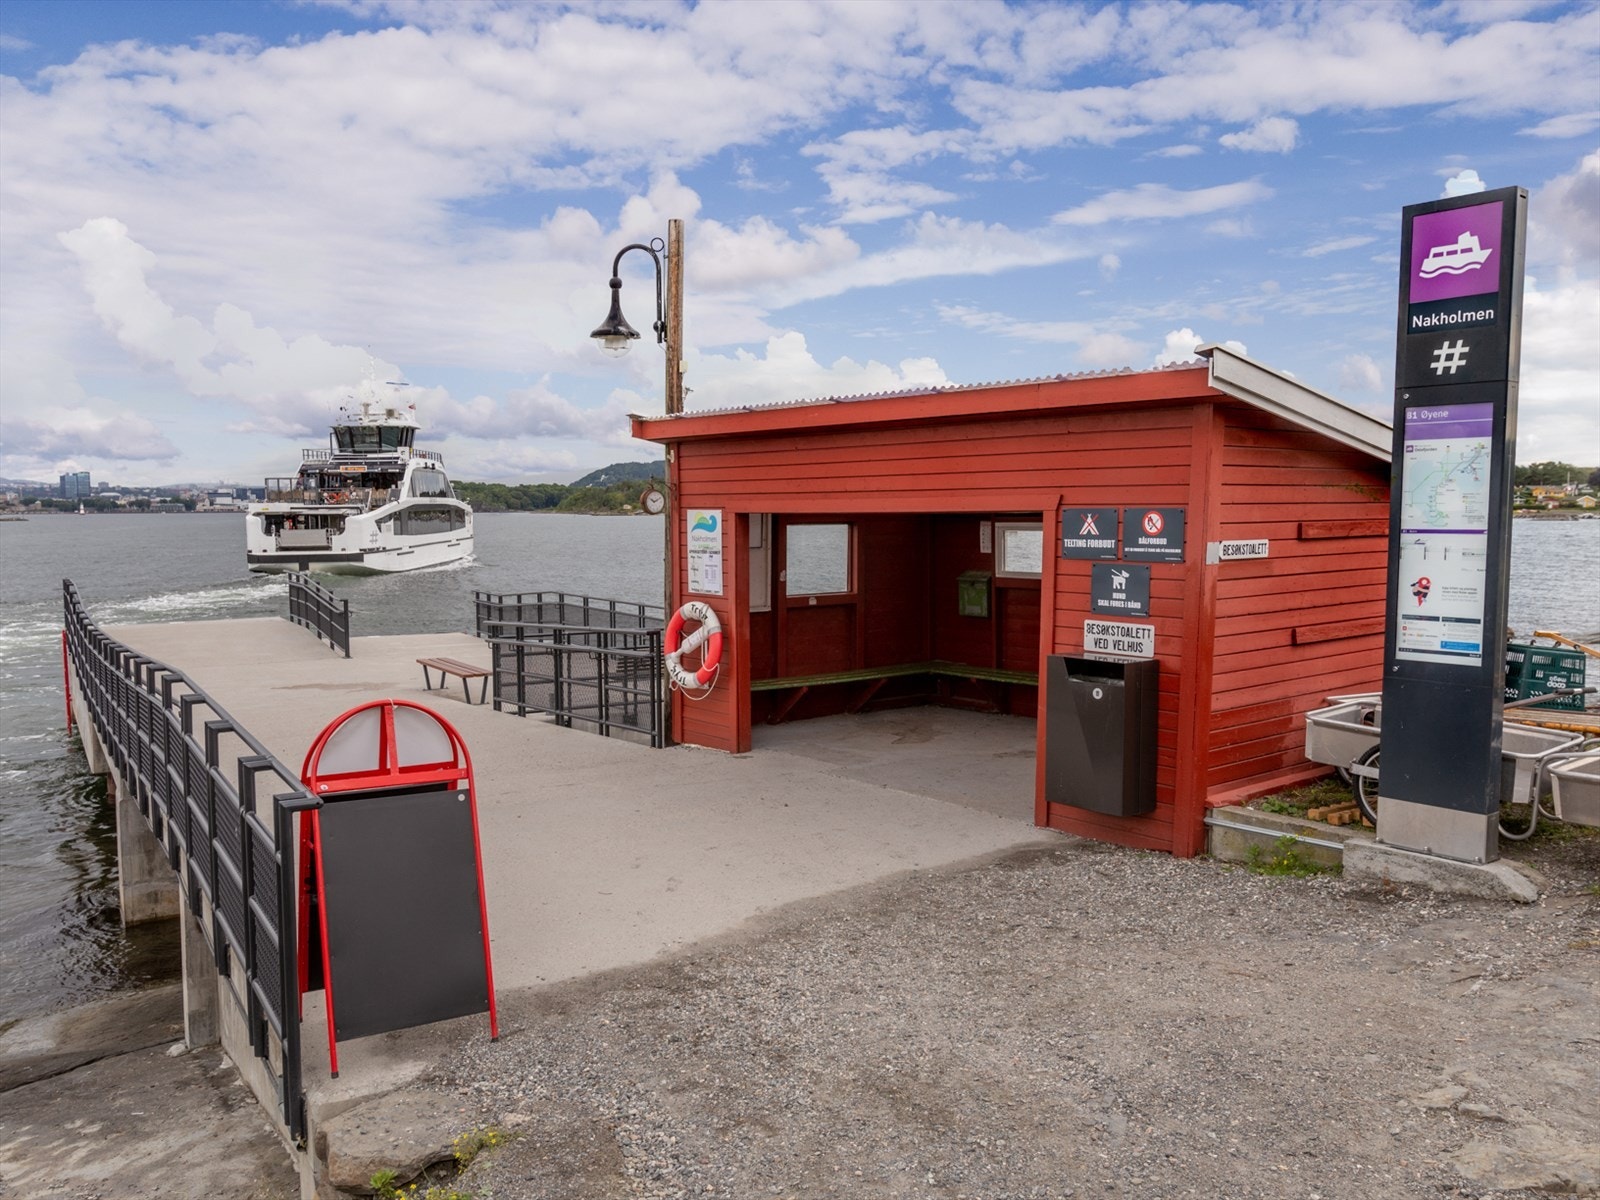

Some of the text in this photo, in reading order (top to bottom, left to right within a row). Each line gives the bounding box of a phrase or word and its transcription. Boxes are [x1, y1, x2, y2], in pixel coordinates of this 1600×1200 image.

[1412, 308, 1494, 328] Nakholmen
[1421, 410, 1449, 420] Øyene
[1064, 538, 1115, 549] TELTING FORBUDT
[1222, 543, 1267, 556] BESØKSTOALETT
[1086, 623, 1152, 640] BESØKSTOALETT
[1093, 637, 1143, 653] VED VELHUS
